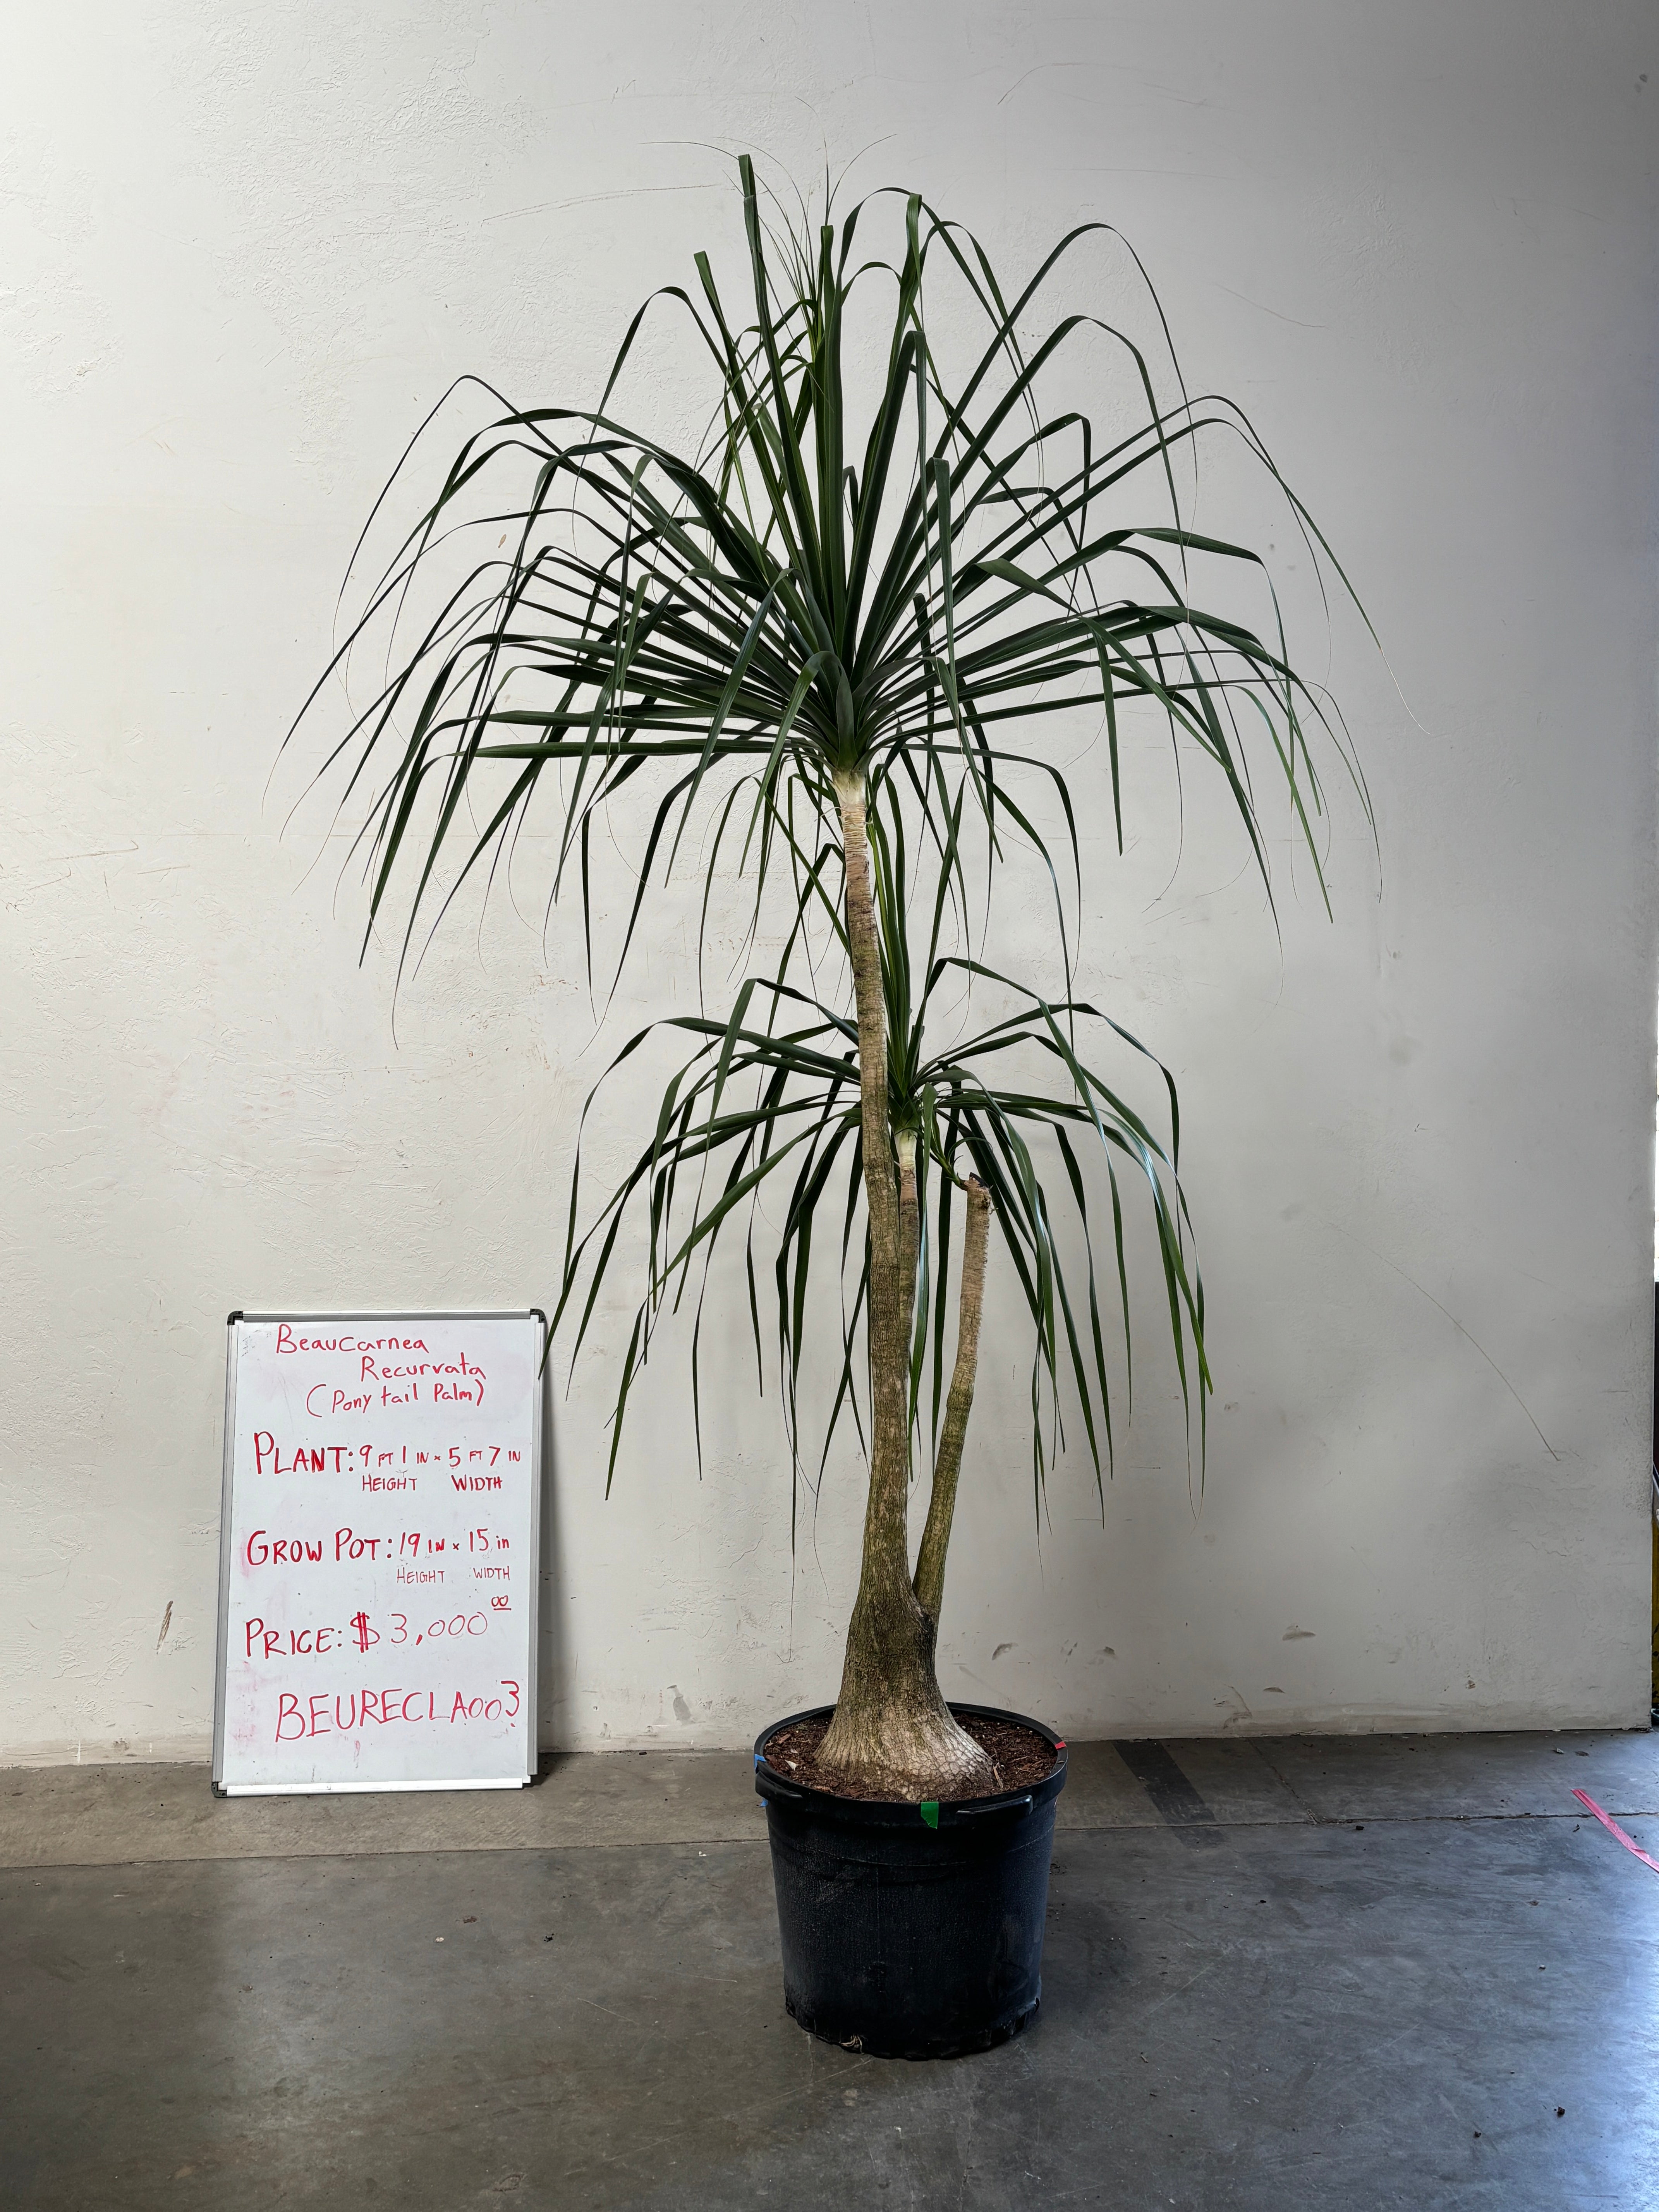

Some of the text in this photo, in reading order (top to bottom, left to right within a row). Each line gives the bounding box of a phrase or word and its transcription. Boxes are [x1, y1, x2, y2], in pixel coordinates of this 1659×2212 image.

[360, 1352, 486, 1382] Recurvata
[380, 1382, 419, 1407] tail
[433, 1378, 484, 1407] Palm)
[253, 1431, 354, 1475] PLANT:
[359, 1444, 373, 1467] 9
[378, 1451, 394, 1467] FT
[402, 1445, 407, 1464] 1
[416, 1451, 429, 1464] IN
[448, 1446, 461, 1468] 5
[468, 1450, 483, 1462] FT
[488, 1446, 501, 1467] 7
[508, 1450, 521, 1463] IN
[362, 1474, 503, 1492] HEIGHT WIDTH
[246, 1530, 323, 1566] GROW
[334, 1527, 392, 1562] POT:
[399, 1532, 421, 1558] 19
[469, 1528, 489, 1553] 15
[496, 1535, 510, 1550] in
[397, 1566, 510, 1584] HEIGHT WIDTH
[245, 1617, 343, 1660] PRICE:
[275, 1680, 520, 1743] BEURECLA003
